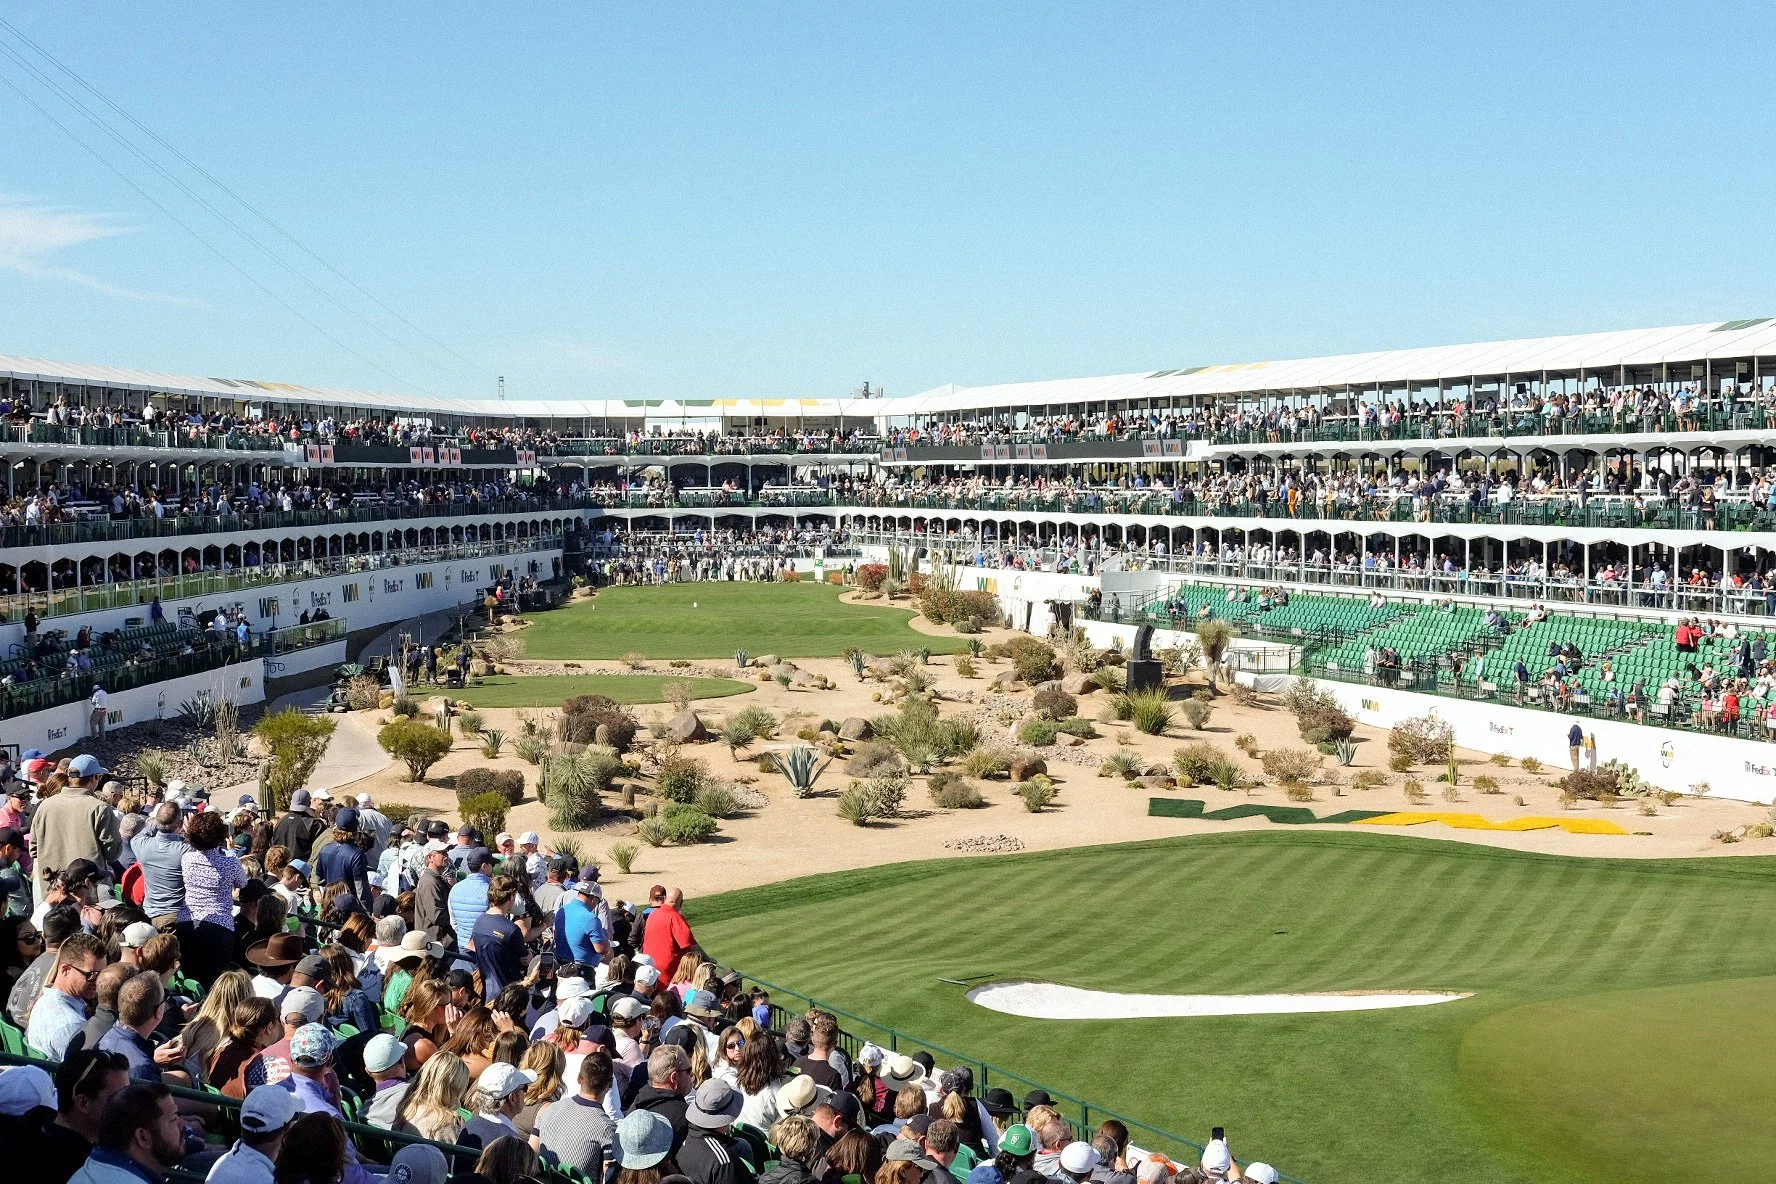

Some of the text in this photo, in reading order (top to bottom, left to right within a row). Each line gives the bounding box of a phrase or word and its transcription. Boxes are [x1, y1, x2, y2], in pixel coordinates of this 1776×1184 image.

[1146, 444, 1160, 453] WM
[416, 572, 433, 589] WM
[977, 577, 998, 593] WM
[342, 583, 358, 603] WM
[1362, 698, 1379, 712] WM
[108, 710, 123, 725] WM
[1494, 724, 1508, 734] FedEx
[1752, 764, 1771, 776] FedEx
